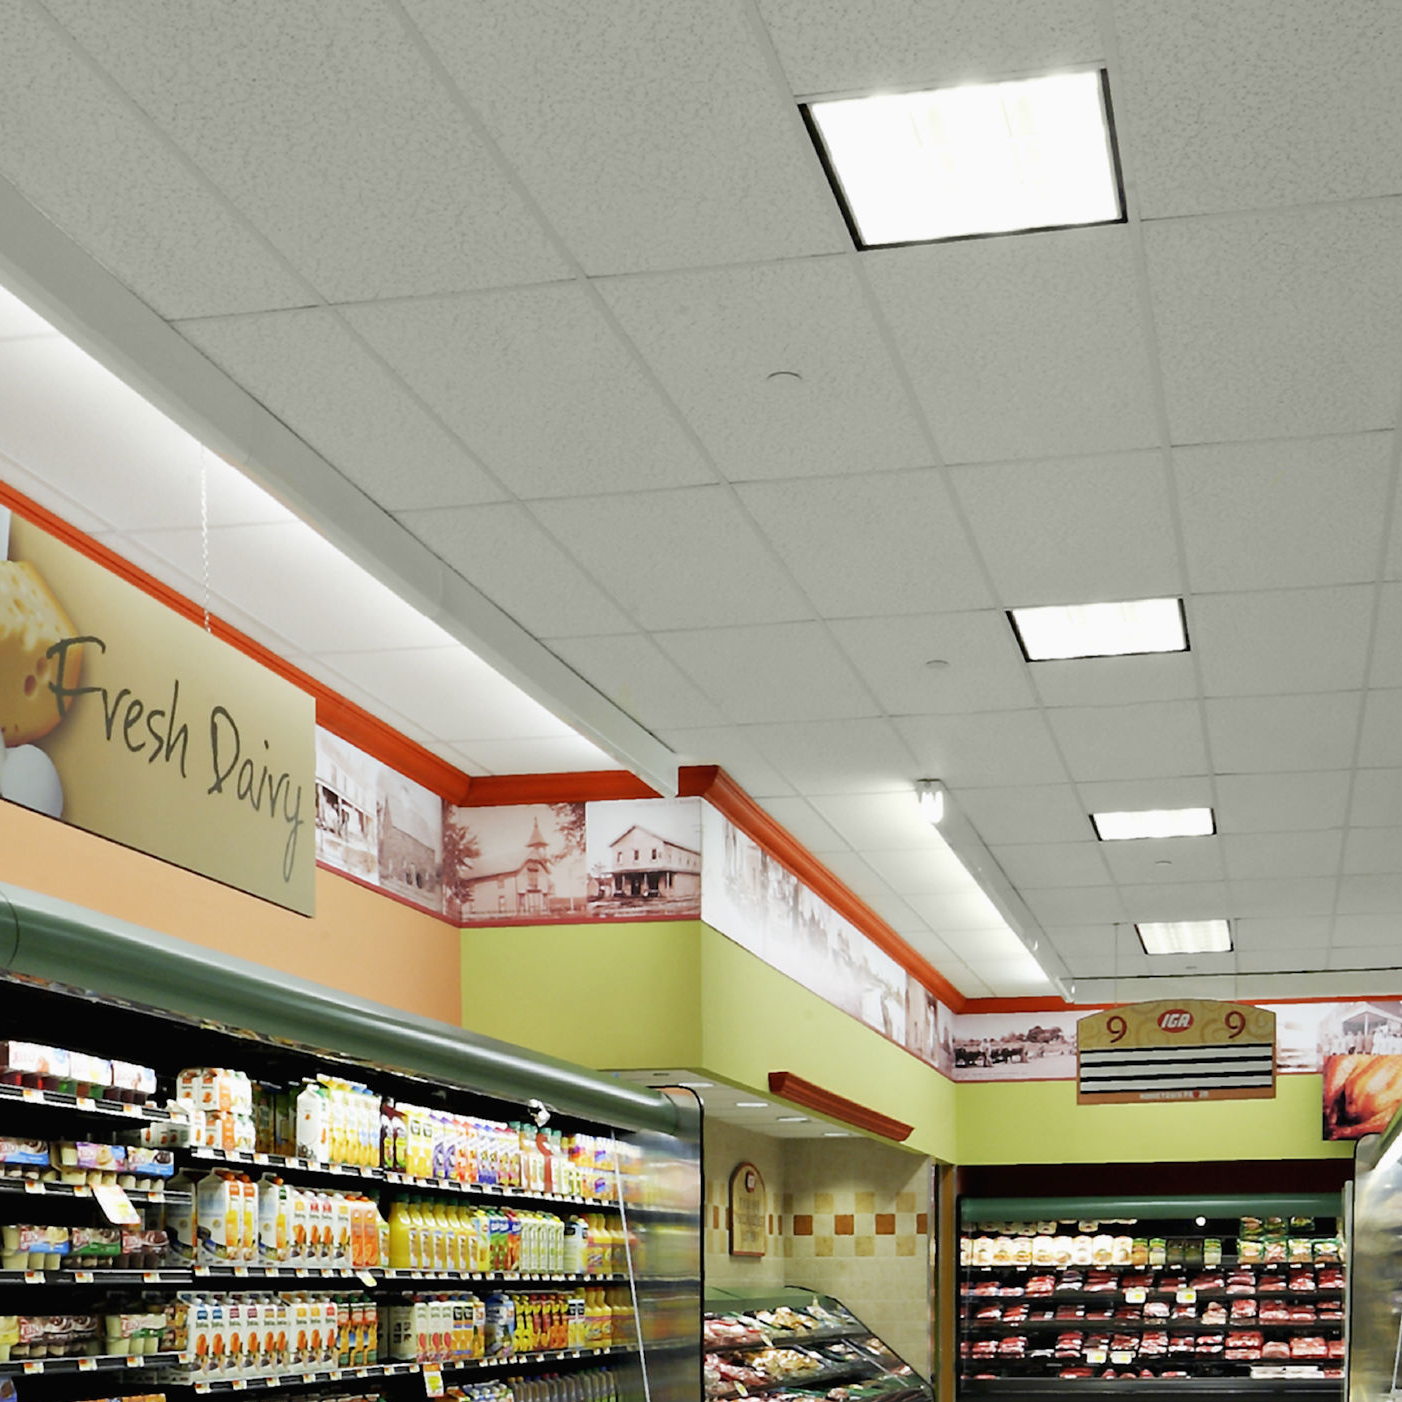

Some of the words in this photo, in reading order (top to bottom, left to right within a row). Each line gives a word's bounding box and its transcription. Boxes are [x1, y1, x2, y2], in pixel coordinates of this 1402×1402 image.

[47, 635, 188, 778] Fresh
[208, 706, 305, 882] Dairy
[1106, 1016, 1128, 1043] 9
[1161, 1014, 1192, 1028] IGA
[1225, 1011, 1246, 1039] 9
